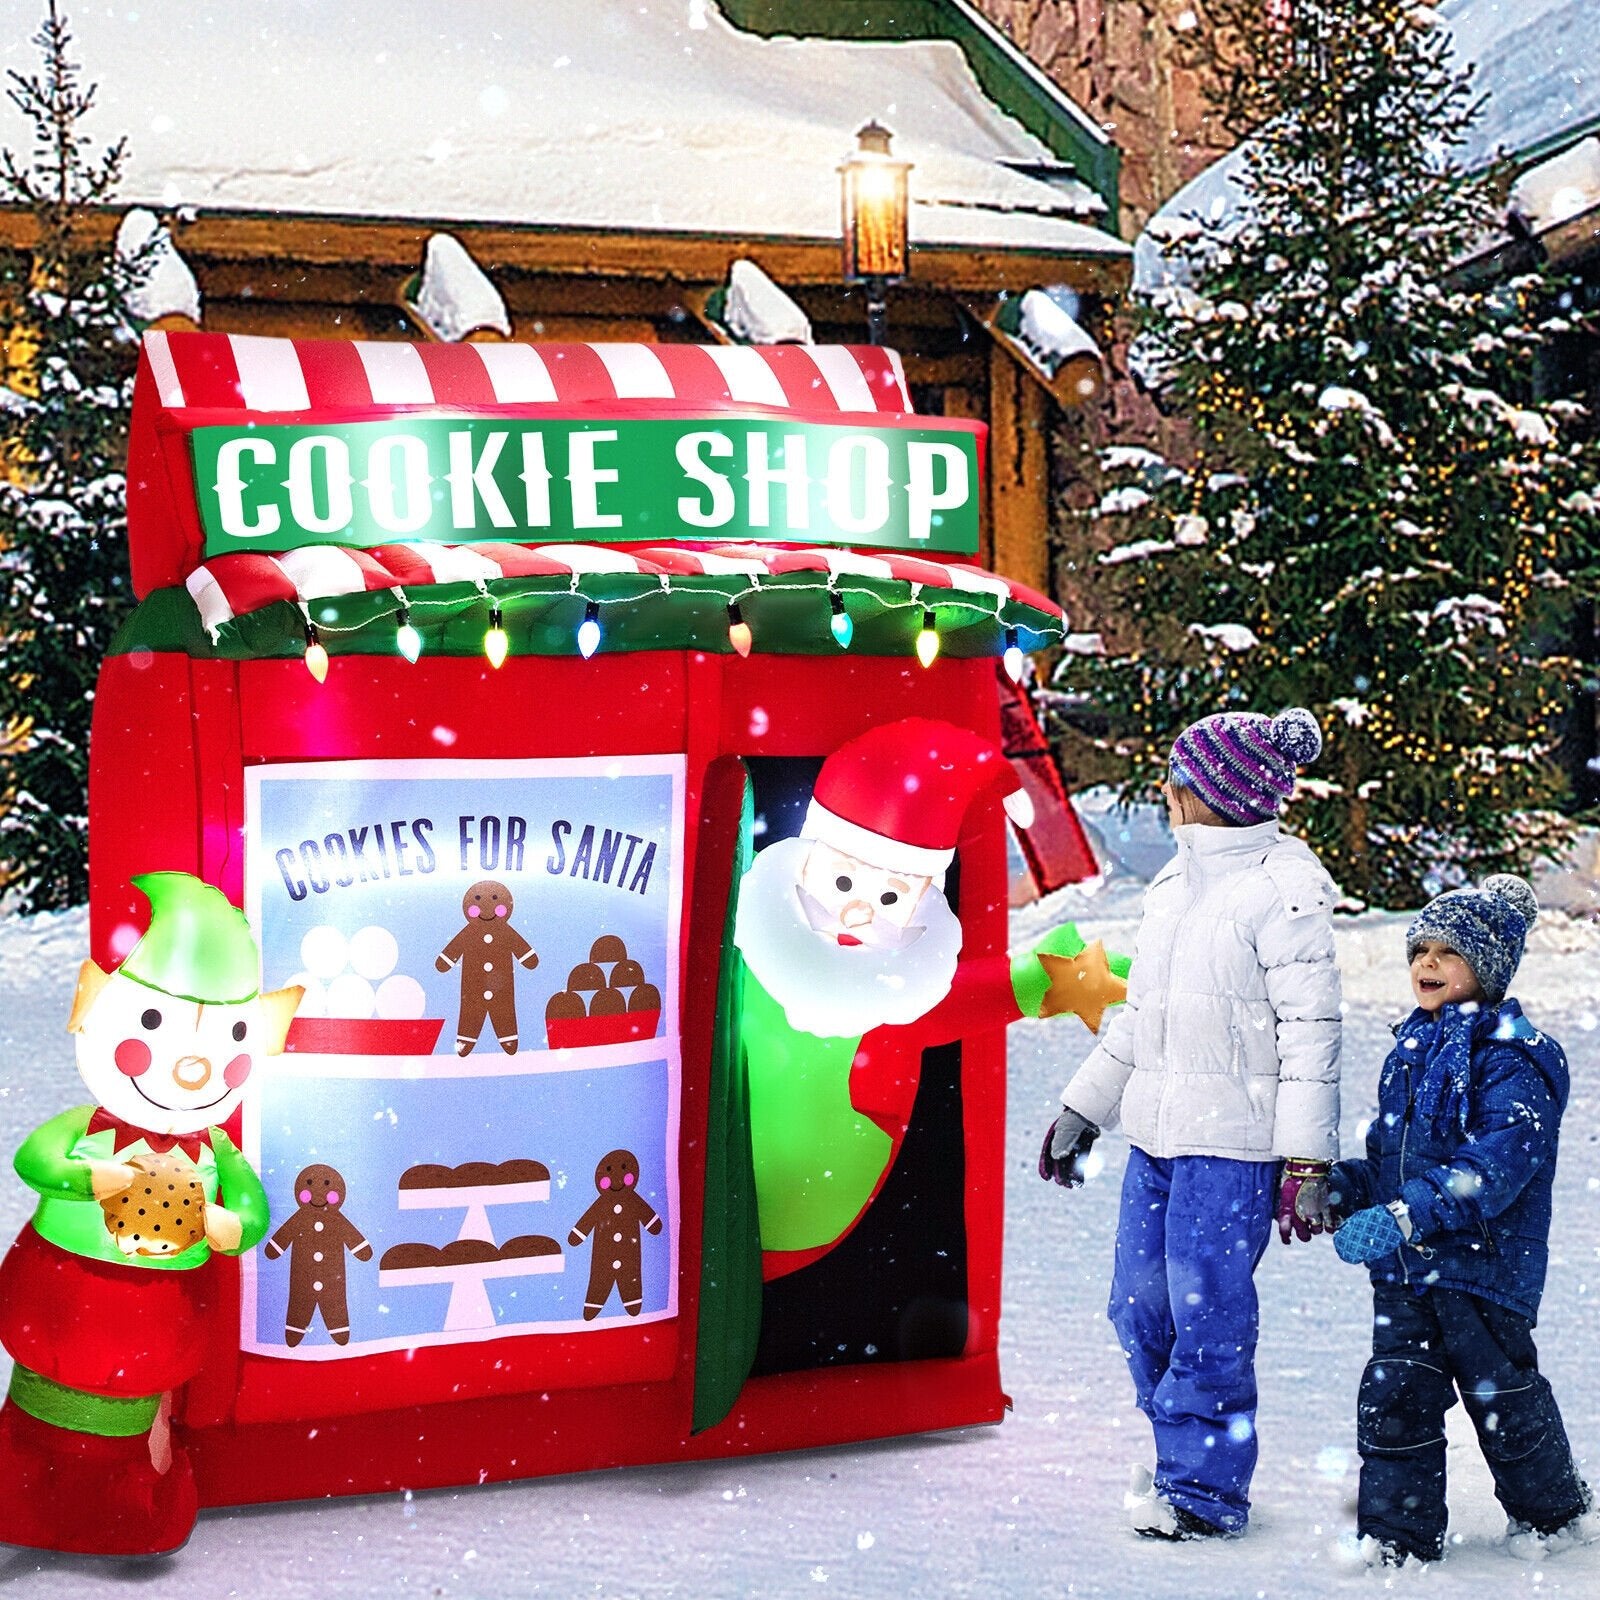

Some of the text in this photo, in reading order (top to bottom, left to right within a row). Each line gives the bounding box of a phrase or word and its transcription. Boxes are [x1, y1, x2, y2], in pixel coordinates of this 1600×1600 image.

[212, 429, 969, 540] COOKIE SHOP
[275, 816, 658, 902] COOKIES FOR SANTA
